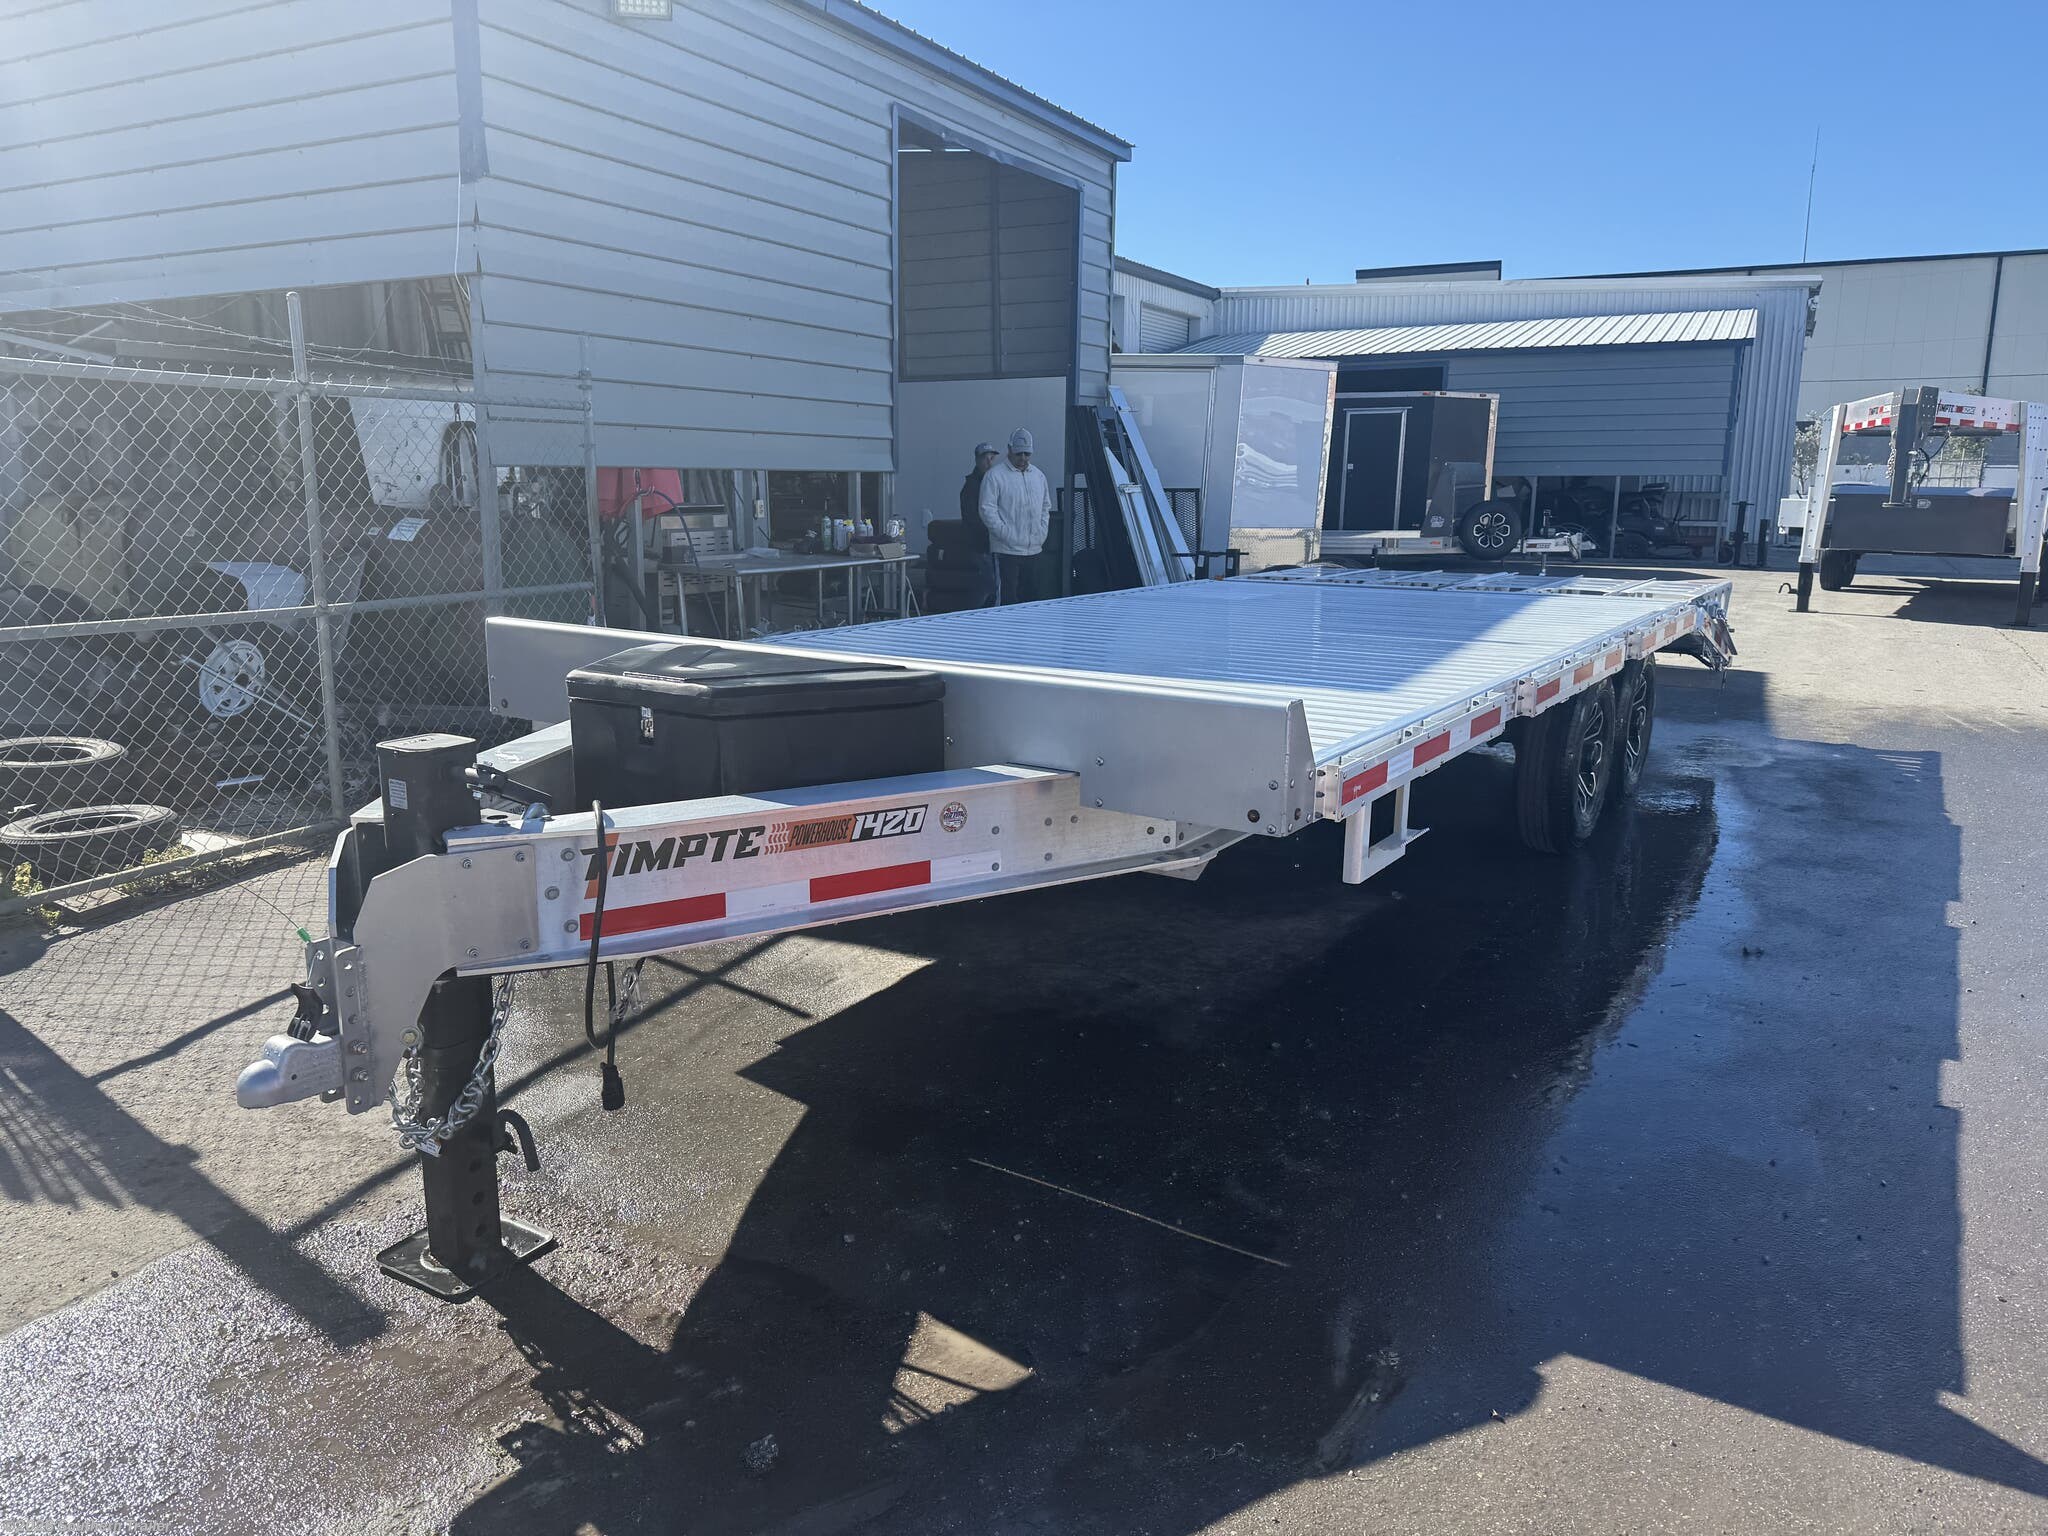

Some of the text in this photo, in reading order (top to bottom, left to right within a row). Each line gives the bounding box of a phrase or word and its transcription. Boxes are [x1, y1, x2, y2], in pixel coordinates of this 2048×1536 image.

[580, 825, 766, 882] TIMPTE
[788, 817, 852, 847] POWERHOUSE
[851, 806, 927, 841] 1420
